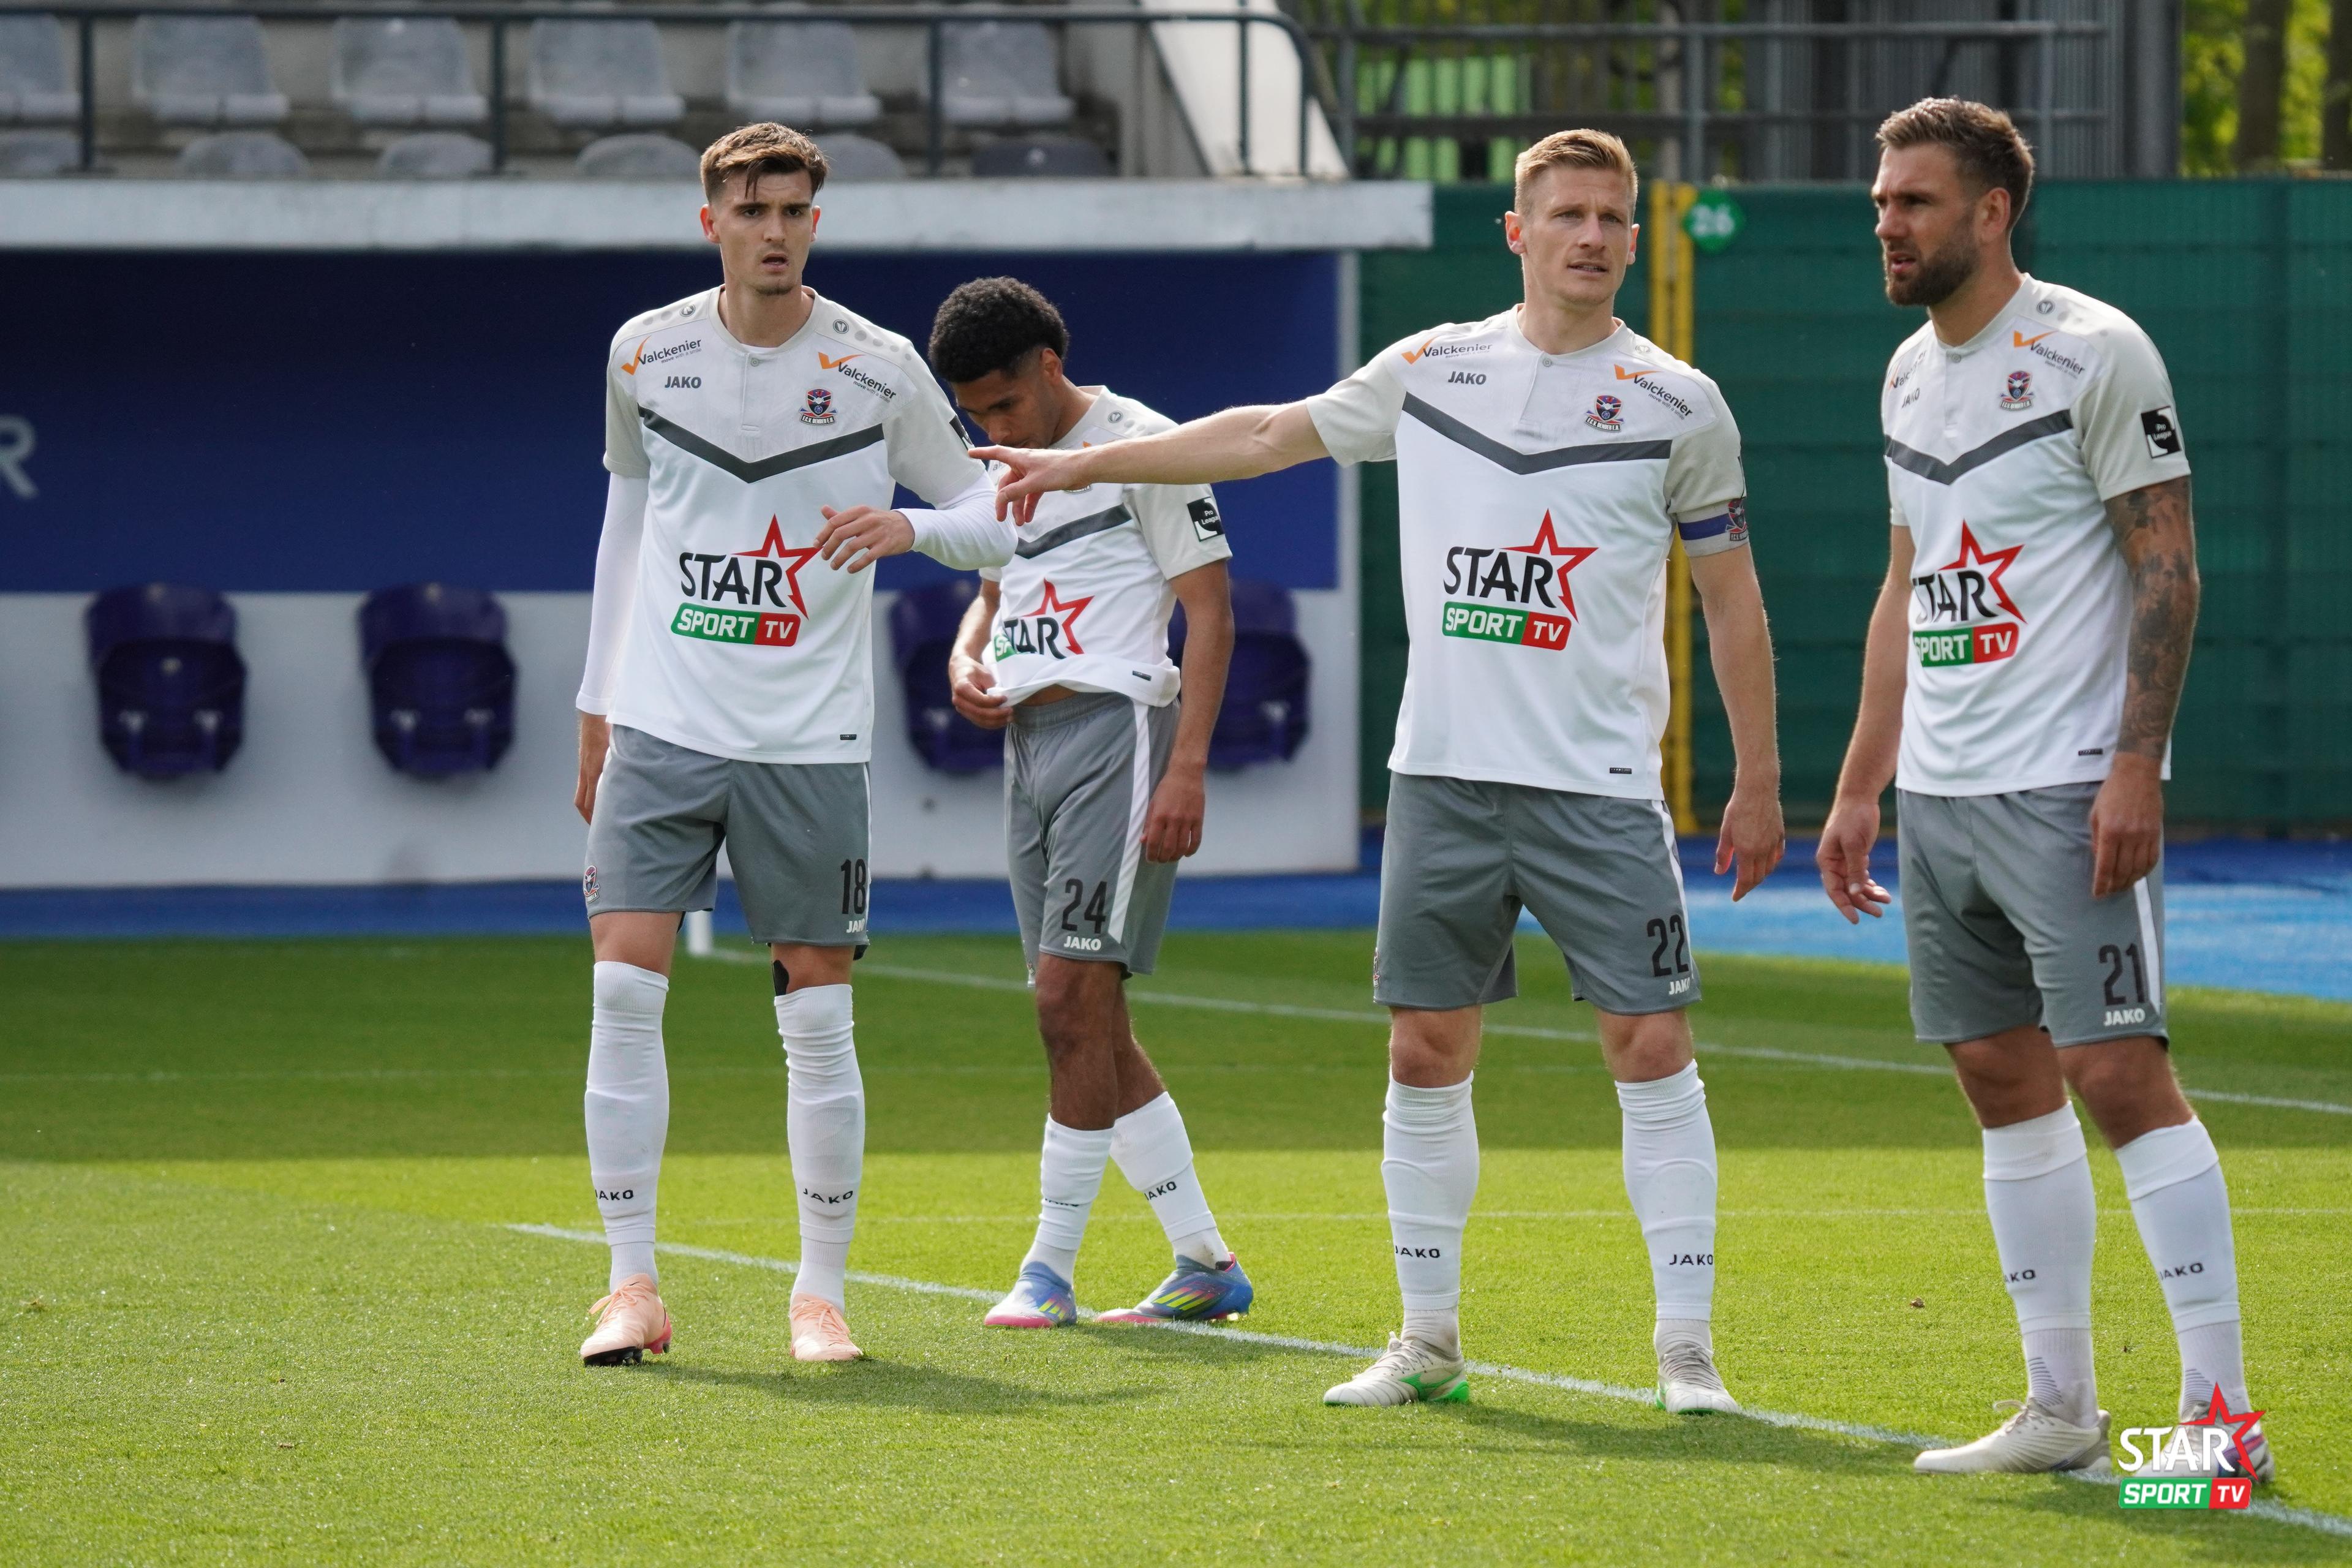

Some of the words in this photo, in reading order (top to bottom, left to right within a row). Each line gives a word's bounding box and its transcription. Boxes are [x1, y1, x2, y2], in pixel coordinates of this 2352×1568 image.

[637, 339, 701, 365] Valckenier
[1423, 344, 1493, 357] Valckenier
[2030, 339, 2086, 374] Valckenier
[665, 376, 702, 389] JAKO
[838, 361, 897, 399] Valckenier
[1448, 371, 1487, 385] JAKO
[1634, 374, 1693, 417] Valckenier
[679, 552, 787, 608] STAR
[1443, 546, 1557, 608] STAR
[677, 608, 755, 638] SPORT
[766, 620, 794, 639] TV
[1003, 617, 1067, 660] TAR
[1446, 607, 1523, 638] SPORT
[1533, 620, 1564, 642] TV
[1979, 630, 2012, 654] TV
[840, 858, 867, 914] 18
[1061, 878, 1108, 934] 24
[1063, 935, 1102, 951] JAKO
[1646, 914, 1689, 978] 22
[2098, 943, 2146, 1006] 21
[2103, 1007, 2146, 1027] JAKO
[803, 1188, 853, 1204] JAKO
[1669, 1254, 1713, 1265] JAKO
[2003, 1269, 2037, 1284] AKO
